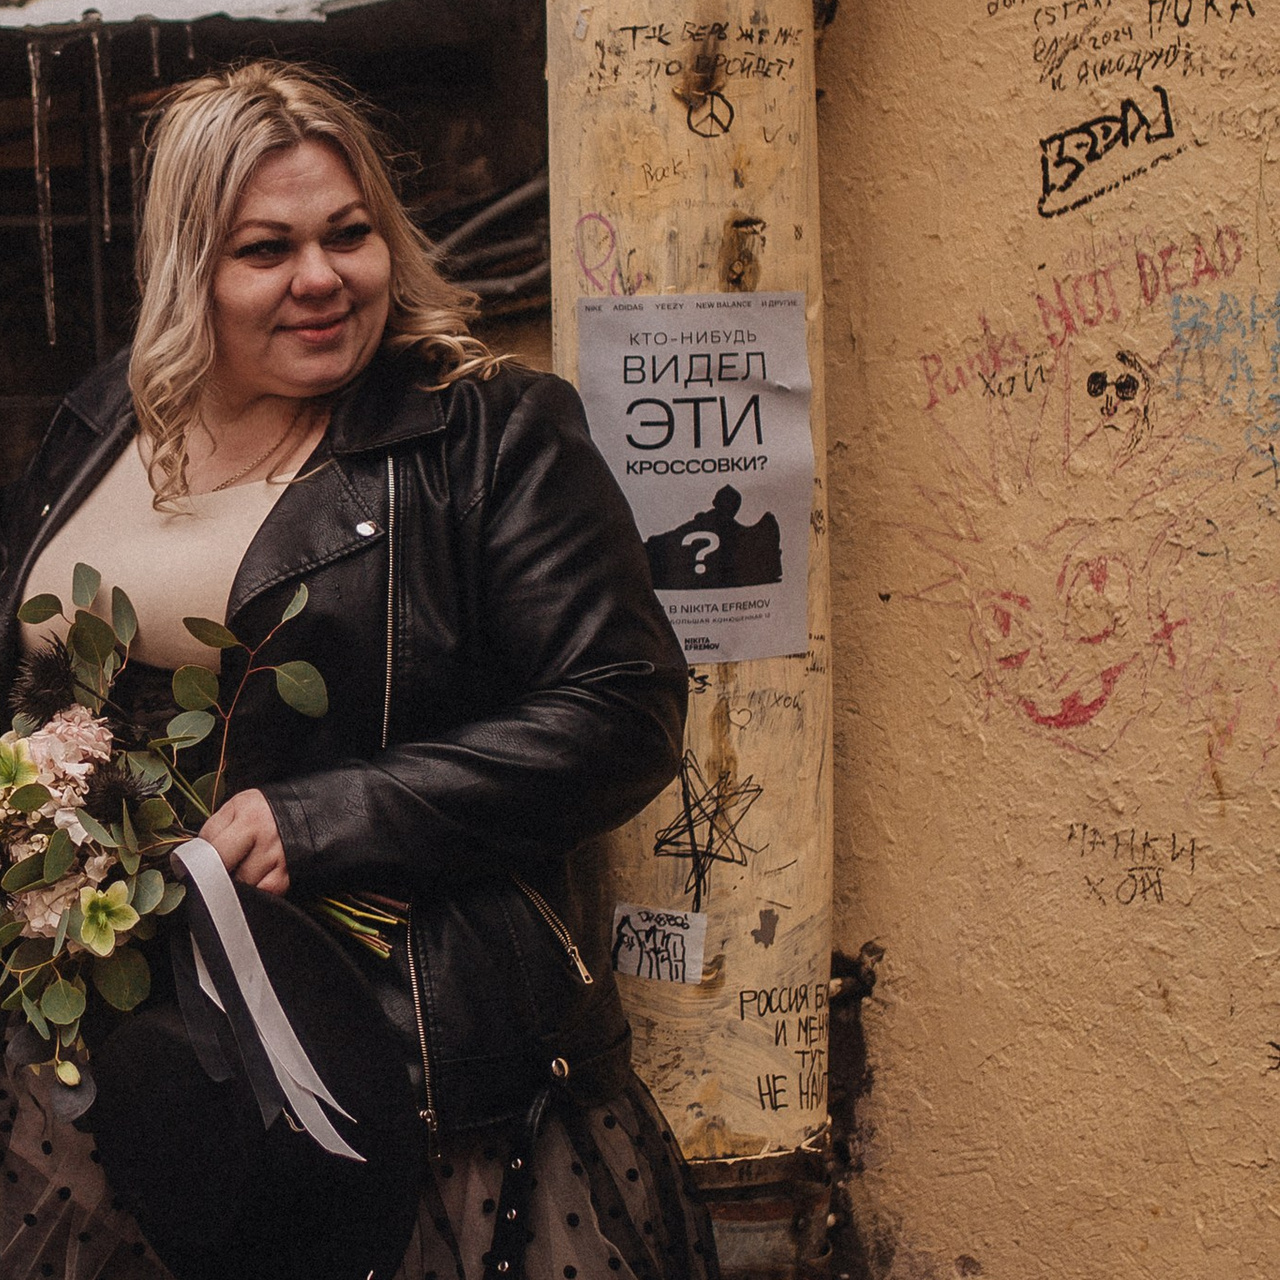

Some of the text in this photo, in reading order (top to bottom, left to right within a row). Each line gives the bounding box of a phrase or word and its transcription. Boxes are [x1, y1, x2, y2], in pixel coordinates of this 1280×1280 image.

[613, 303, 644, 312] ADIDAS
[629, 330, 757, 346] КТО-НИБУДЬ
[622, 351, 767, 389] ВИДЕЛ
[626, 394, 764, 450] ЭТИ
[626, 455, 768, 475] КРОССОВКИ?
[680, 603, 719, 614] NIKITA
[721, 598, 771, 612] EFREMOV
[684, 643, 720, 651] EFREMOV
[739, 983, 809, 1021] РОССИЯ
[775, 1019, 787, 1047] И
[757, 1073, 789, 1112] НЕ
